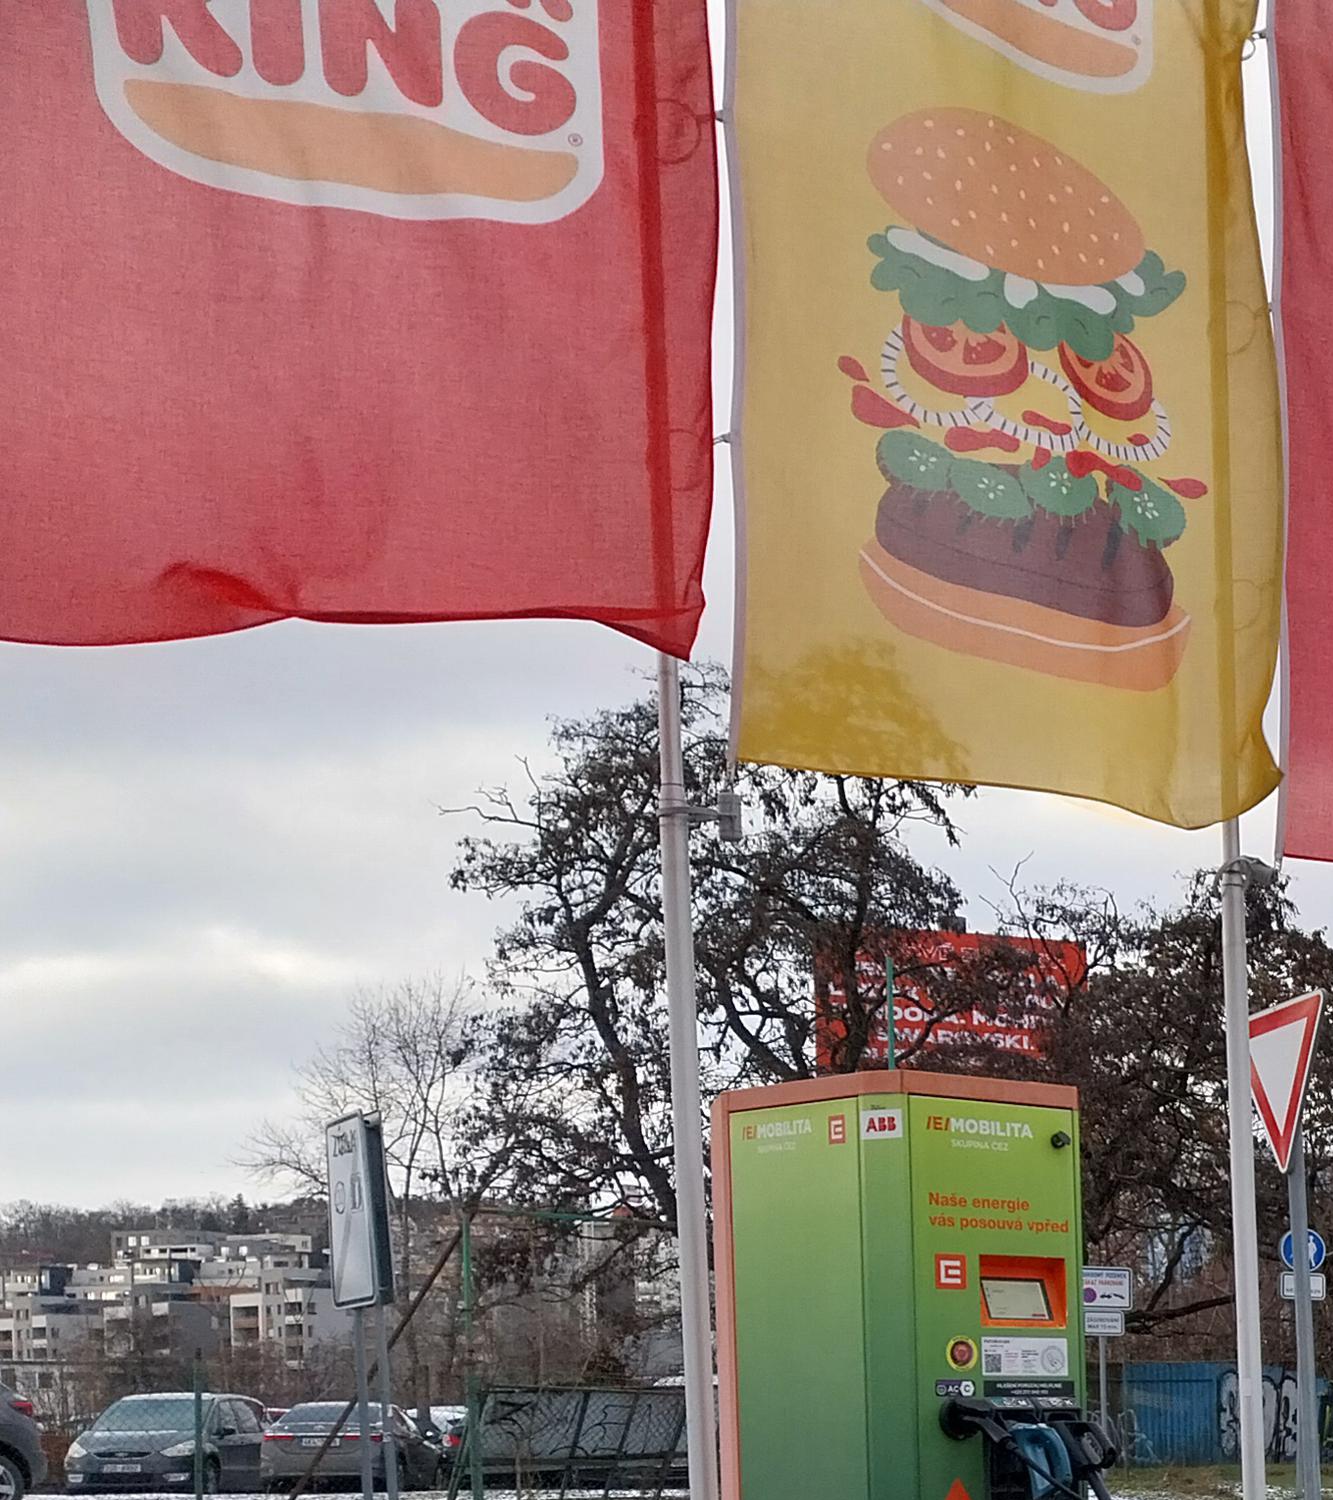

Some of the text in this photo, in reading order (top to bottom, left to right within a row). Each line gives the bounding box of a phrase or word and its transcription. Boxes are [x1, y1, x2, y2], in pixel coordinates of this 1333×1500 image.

[866, 1115, 896, 1133] ABB
[928, 1191, 1030, 1214] Naše energie
[928, 1212, 1070, 1234] vás posouvá vpřed
[947, 1385, 959, 1393] AC
